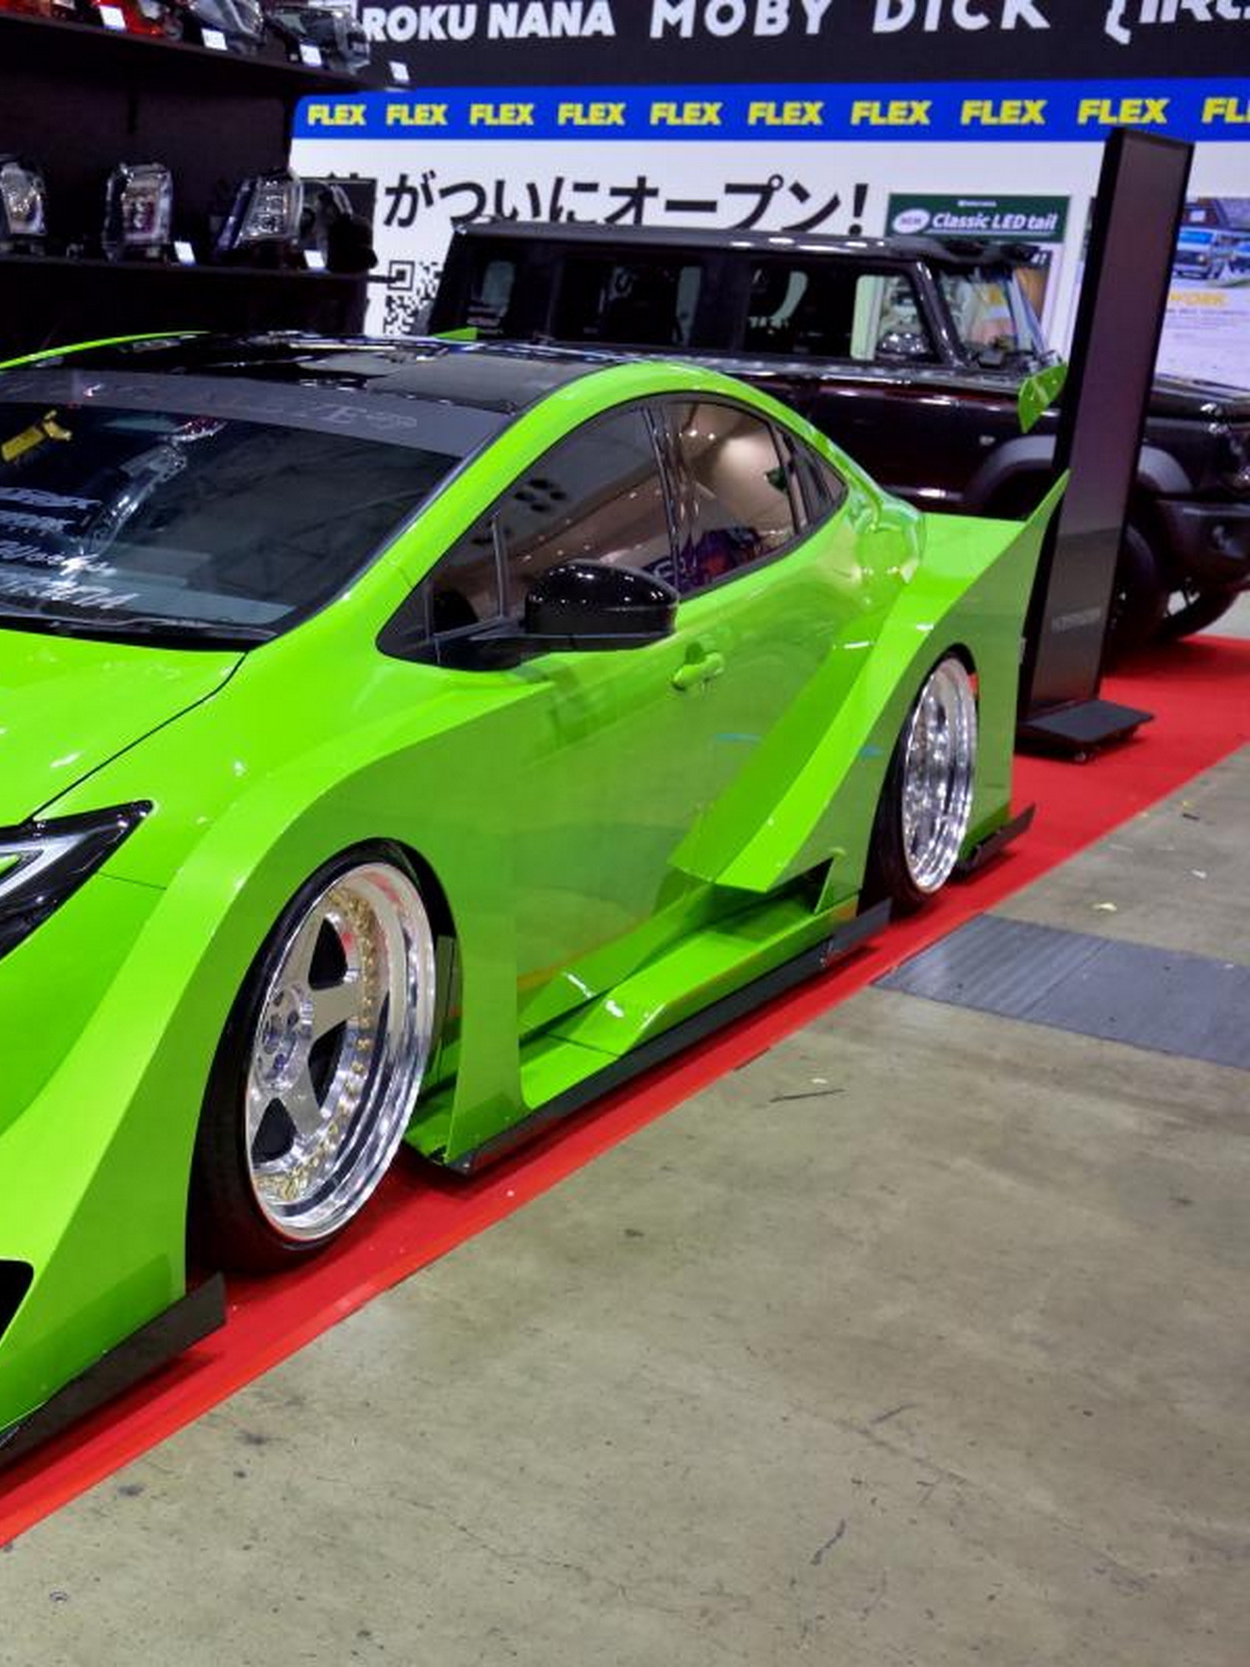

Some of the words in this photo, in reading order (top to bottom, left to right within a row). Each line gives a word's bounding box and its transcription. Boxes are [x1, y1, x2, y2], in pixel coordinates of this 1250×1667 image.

[362, 4, 478, 41] ROKU
[487, 0, 616, 39] NANA
[650, 0, 833, 38] MOBY
[872, 0, 1050, 33] DICK
[307, 103, 366, 126] FLEX
[386, 103, 448, 126] FLEX
[470, 103, 534, 126] FLEX
[558, 102, 626, 126] FLEX
[650, 102, 723, 126] FLEX
[748, 101, 823, 126] FLEX
[850, 101, 930, 125] FLEX
[960, 99, 1047, 125] FLEX
[1077, 98, 1170, 124] FLEX
[1202, 97, 1250, 123] FL
[320, 169, 869, 236] がついにオープン!
[932, 212, 990, 230] Classic
[991, 214, 1026, 231] LED
[1027, 214, 1058, 231] tail
